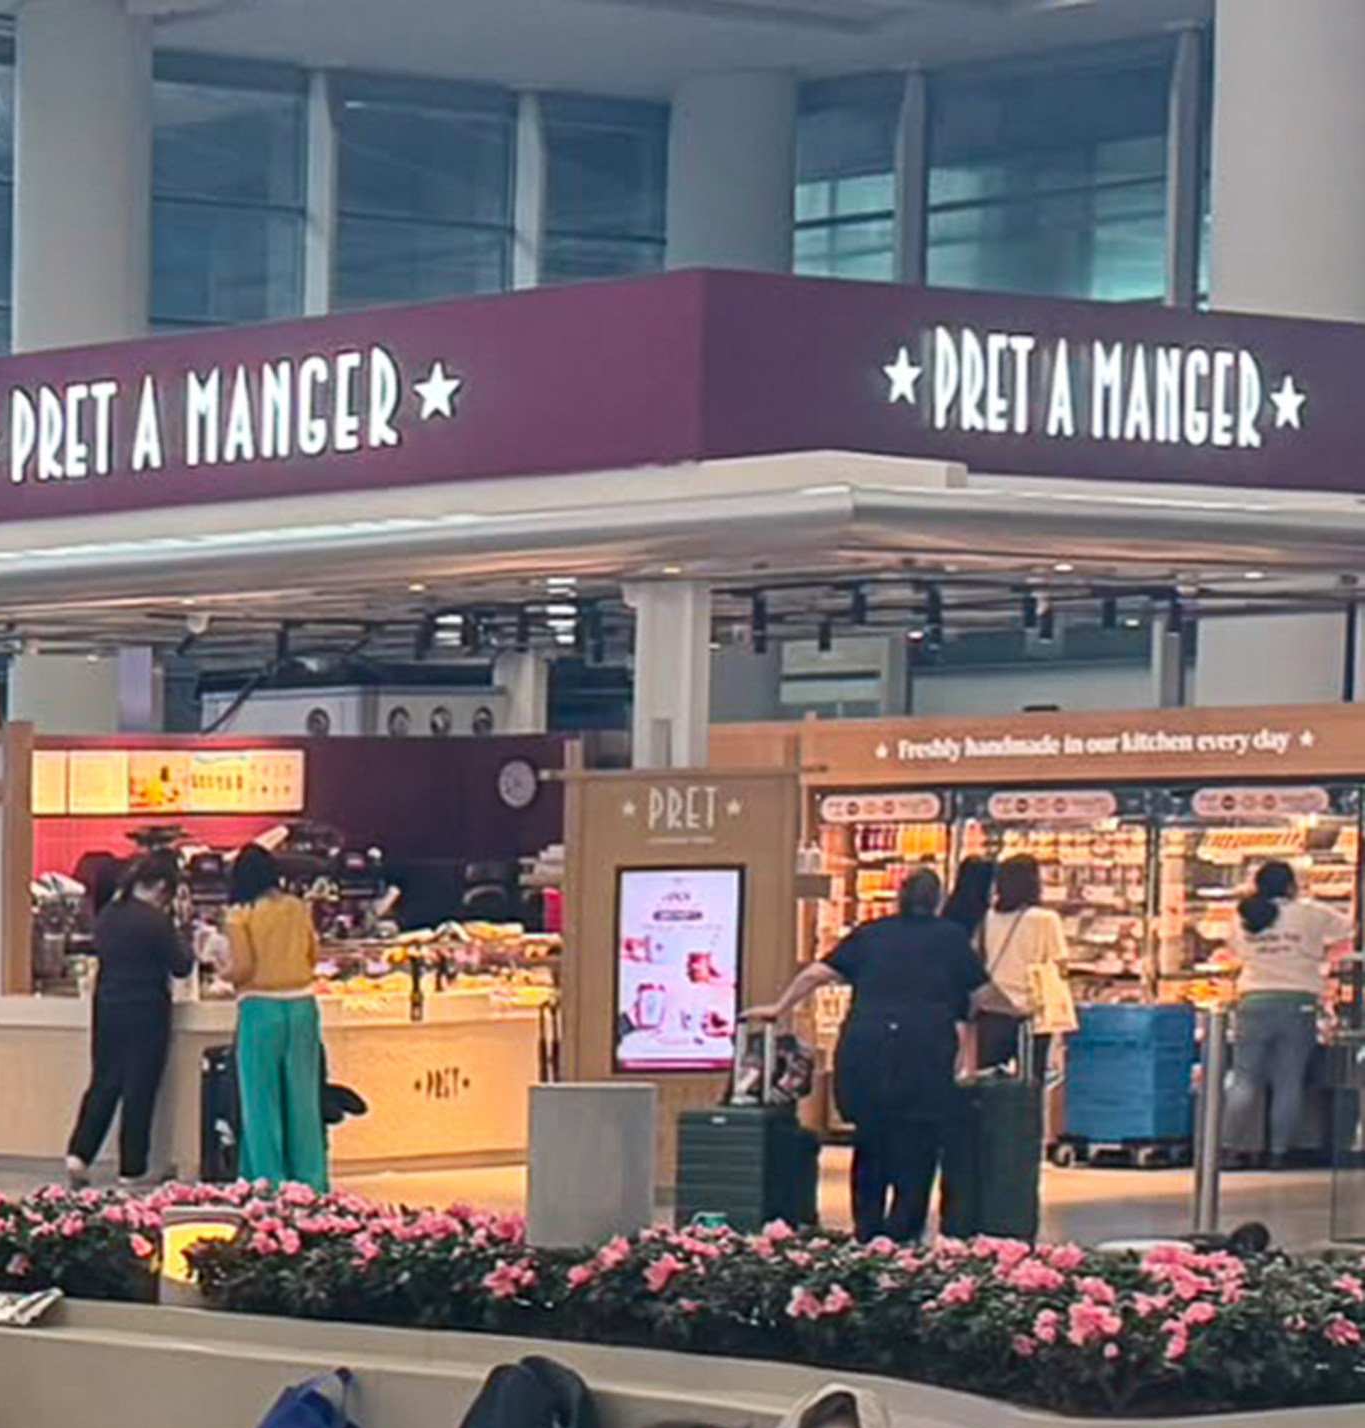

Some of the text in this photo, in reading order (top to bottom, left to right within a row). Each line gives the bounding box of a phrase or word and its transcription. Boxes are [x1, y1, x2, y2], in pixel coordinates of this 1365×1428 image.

[8, 344, 400, 483] PRET A MANGER
[933, 325, 1262, 448] PRET A MANGER
[897, 729, 1291, 763] Freshly handmade in our kitchen every day
[647, 786, 718, 831] PRET
